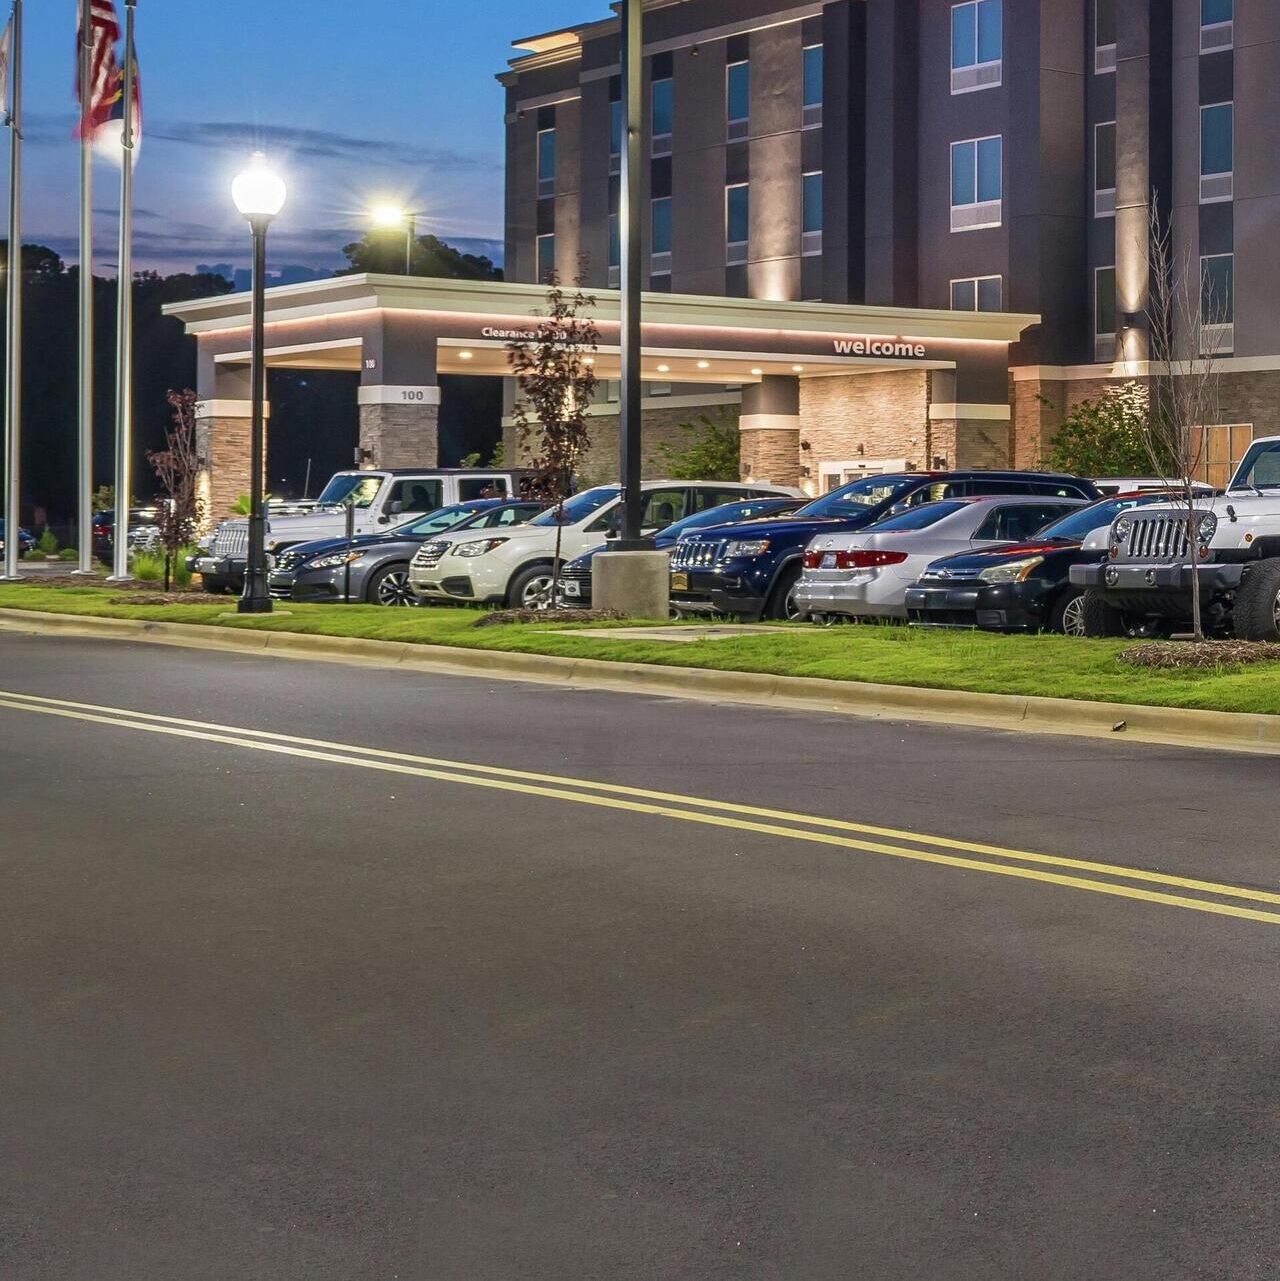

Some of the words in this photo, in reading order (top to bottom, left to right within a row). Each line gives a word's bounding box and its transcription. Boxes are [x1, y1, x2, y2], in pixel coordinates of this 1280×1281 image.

[481, 326, 535, 339] Clearance
[833, 336, 926, 357] welcome
[401, 390, 424, 401] 100
